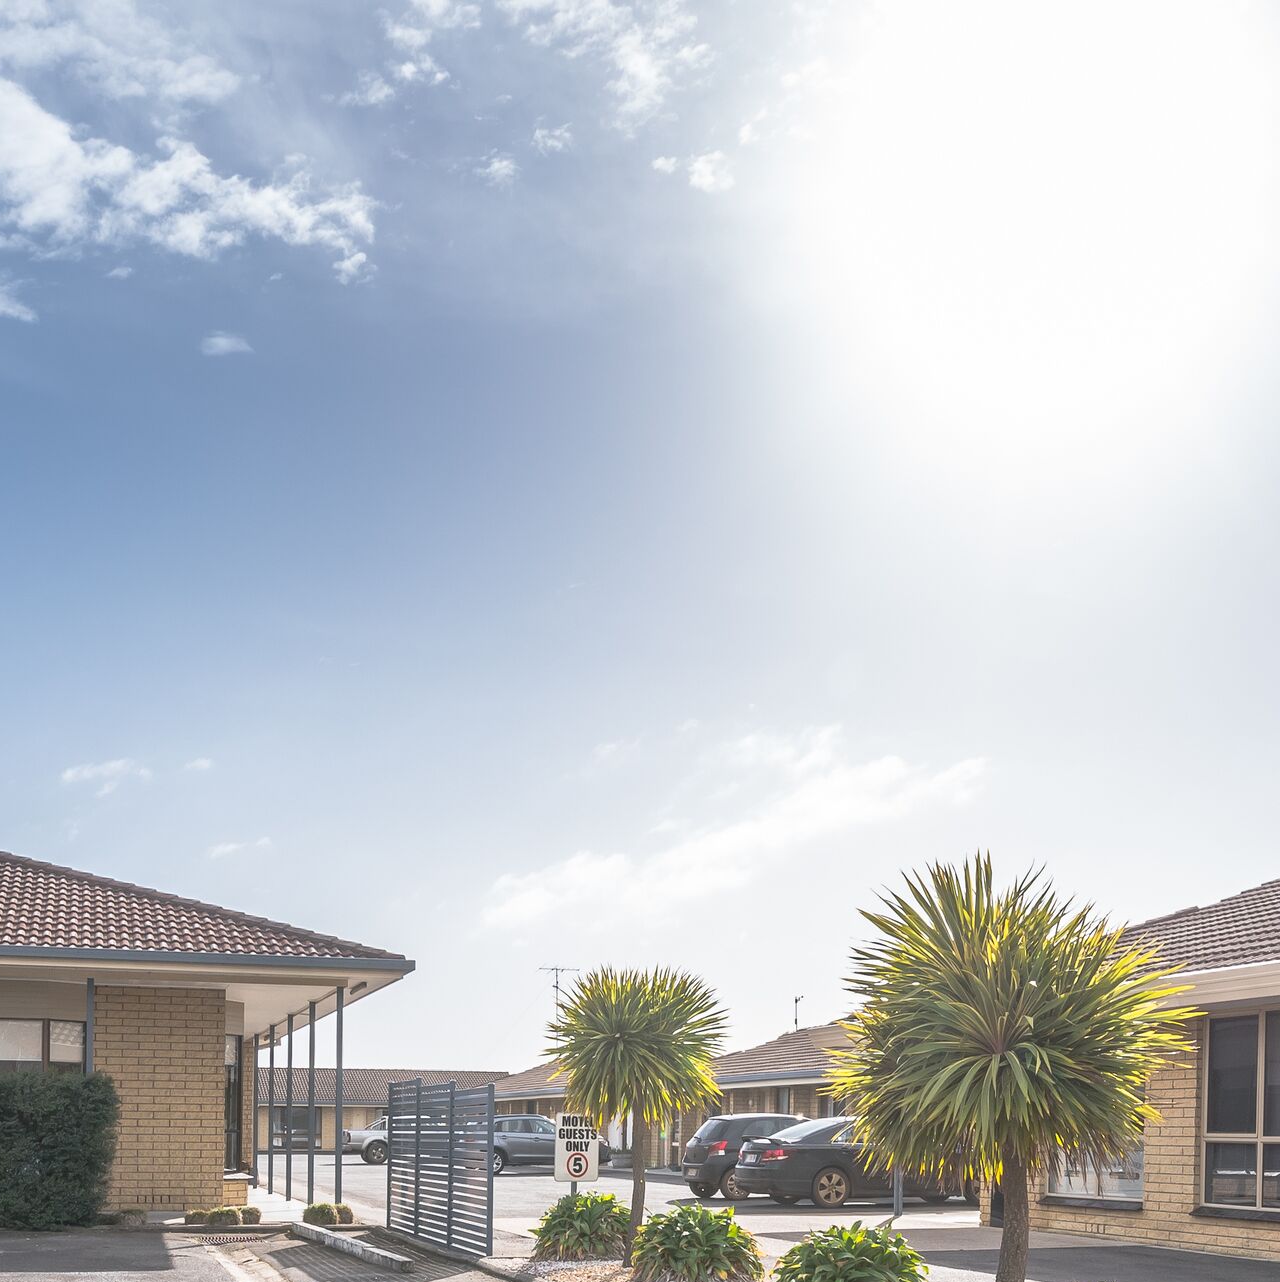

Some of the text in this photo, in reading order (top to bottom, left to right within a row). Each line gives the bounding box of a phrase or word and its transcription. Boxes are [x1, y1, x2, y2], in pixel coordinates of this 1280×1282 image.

[559, 1128, 597, 1140] GUESTS
[566, 1141, 590, 1152] ONLY
[572, 1157, 583, 1174] 5
